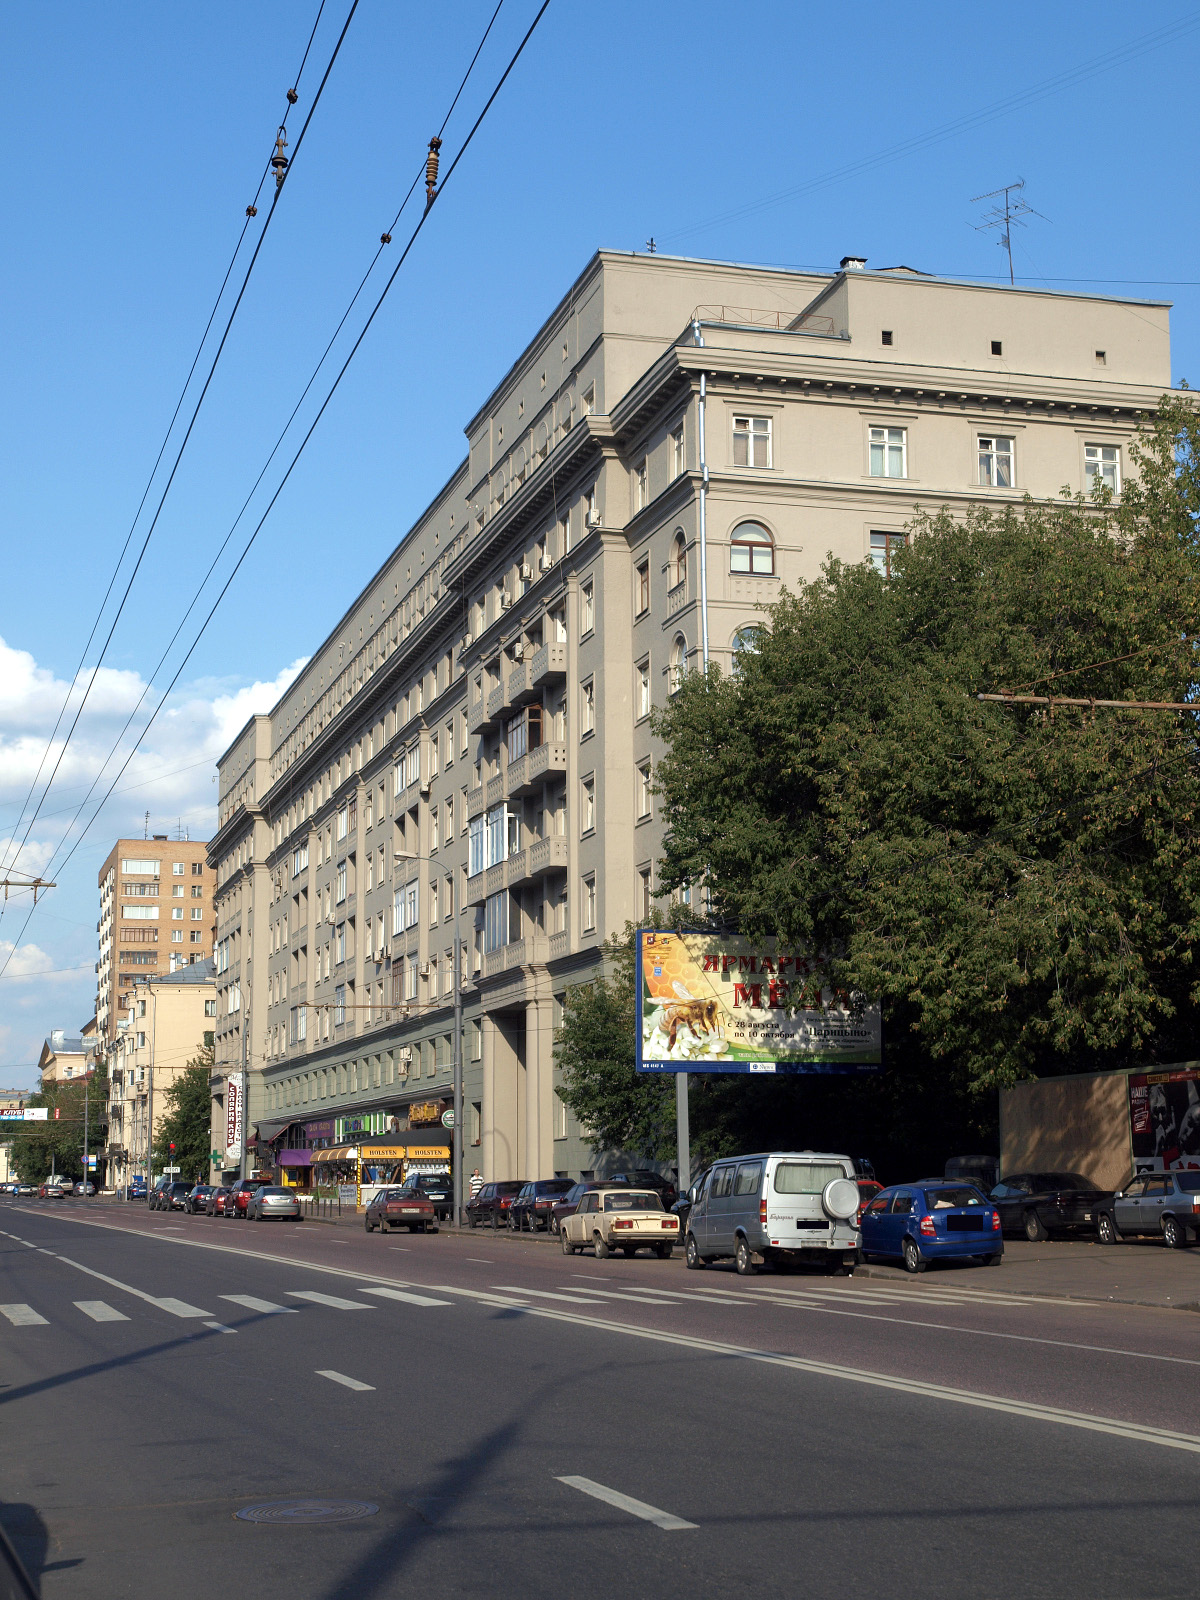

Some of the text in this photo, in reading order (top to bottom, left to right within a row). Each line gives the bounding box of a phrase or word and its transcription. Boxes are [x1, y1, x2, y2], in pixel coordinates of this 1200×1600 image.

[702, 954, 828, 975] ЯРМАРК
[747, 1022, 780, 1030] августа
[760, 1030, 795, 1040] октября
